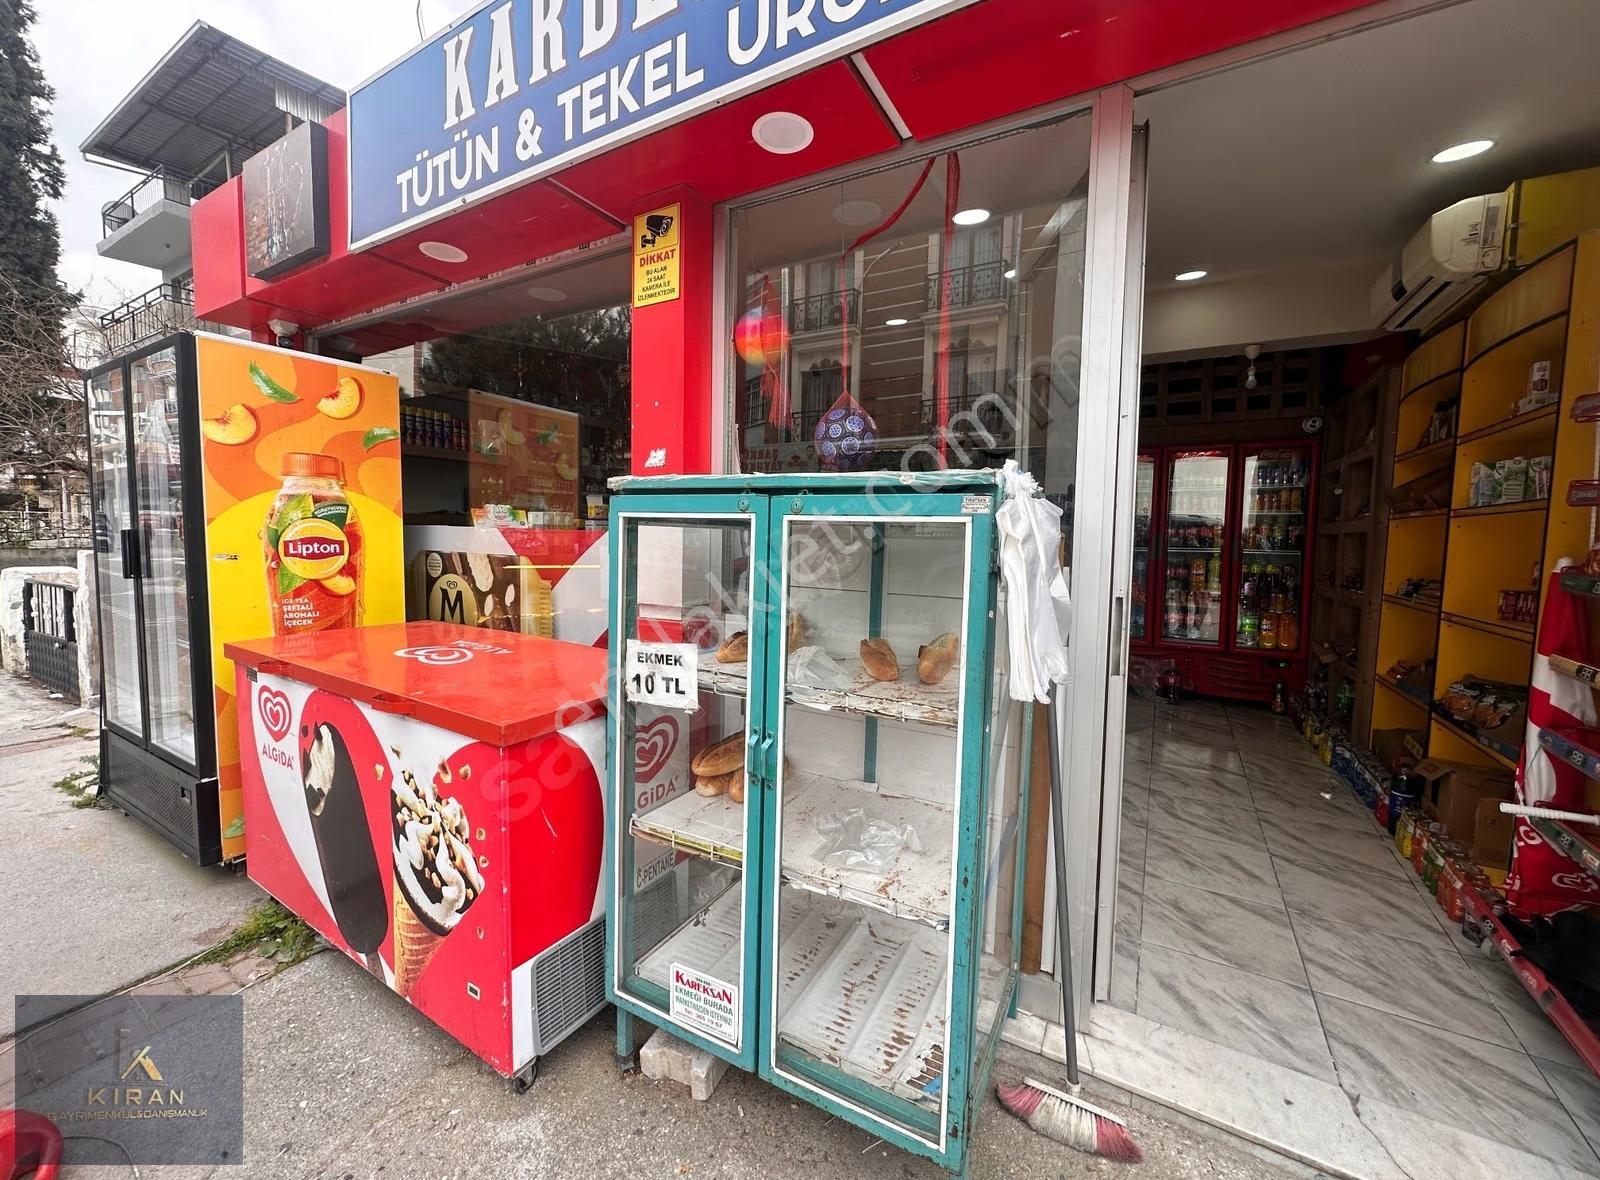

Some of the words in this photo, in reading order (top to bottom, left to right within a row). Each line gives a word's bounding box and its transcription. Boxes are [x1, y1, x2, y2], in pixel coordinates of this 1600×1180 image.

[396, 125, 498, 213] TÜTÜN
[515, 108, 543, 161] &
[557, 32, 704, 142] TEKEL
[640, 249, 676, 267] DİKKAT
[653, 265, 667, 274] ALAN
[653, 274, 666, 283] SAAT
[642, 283, 662, 292] KAMERA
[288, 541, 340, 557] Lipton
[283, 611, 320, 619] AROMALI
[637, 651, 683, 667] EKMEK
[631, 672, 655, 695] 10
[661, 676, 686, 695] TL
[675, 970, 732, 1005] KAREKSAN
[703, 998, 733, 1016] BURADA
